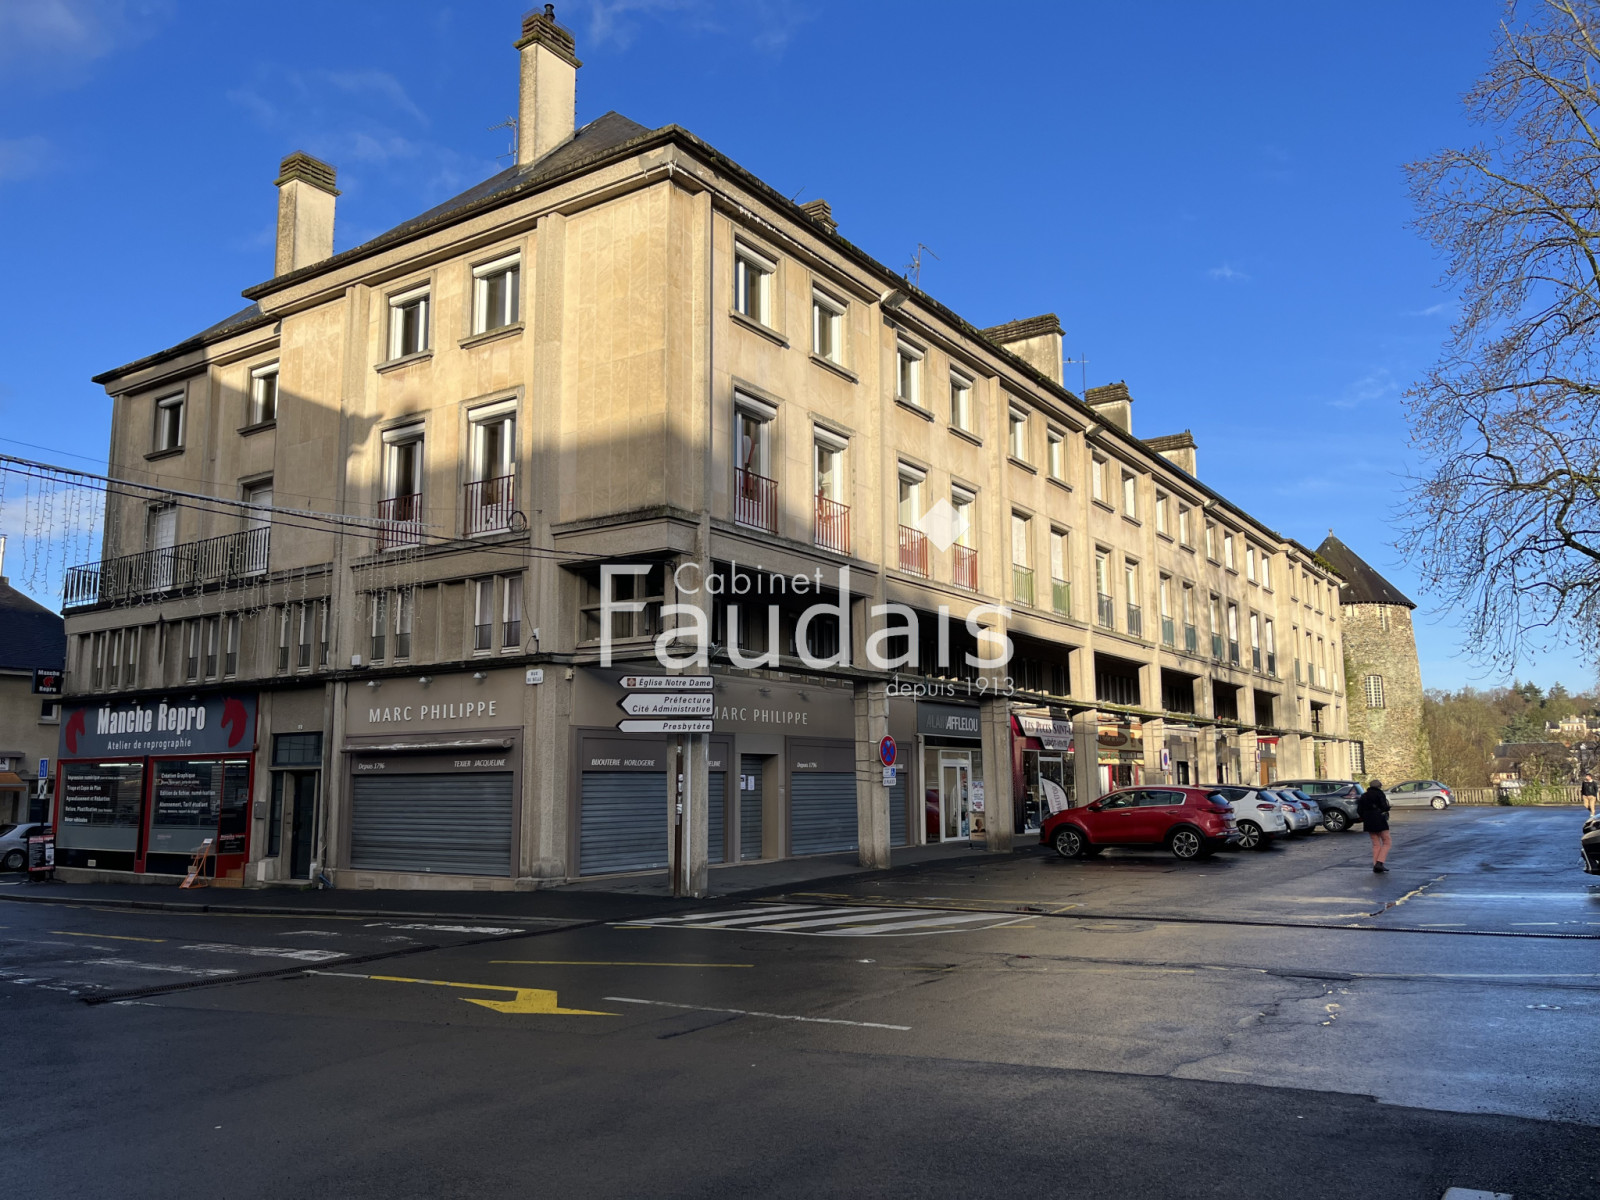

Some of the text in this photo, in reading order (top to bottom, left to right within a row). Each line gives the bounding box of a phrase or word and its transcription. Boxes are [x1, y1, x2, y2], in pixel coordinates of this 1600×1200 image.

[38, 669, 60, 677] Manche
[639, 677, 711, 688] Église Notre Dame
[39, 685, 57, 693] Repro
[664, 696, 711, 704] Préfecture
[369, 700, 497, 723] MARC PHILIPPE
[632, 704, 711, 713] Cité Administrative
[97, 703, 206, 735] Manche Repro
[713, 706, 808, 725] MARC PHILIPPE
[662, 722, 711, 731] Presbytère
[946, 716, 978, 732] AFFLELOU
[1035, 721, 1052, 734] PUCES
[107, 738, 192, 751] Atelier de reprographie
[358, 762, 374, 770] Depuis
[454, 759, 506, 768] TEXIER JACQUELINE
[591, 758, 655, 767] BIJOUTERIE HORLOGERIE
